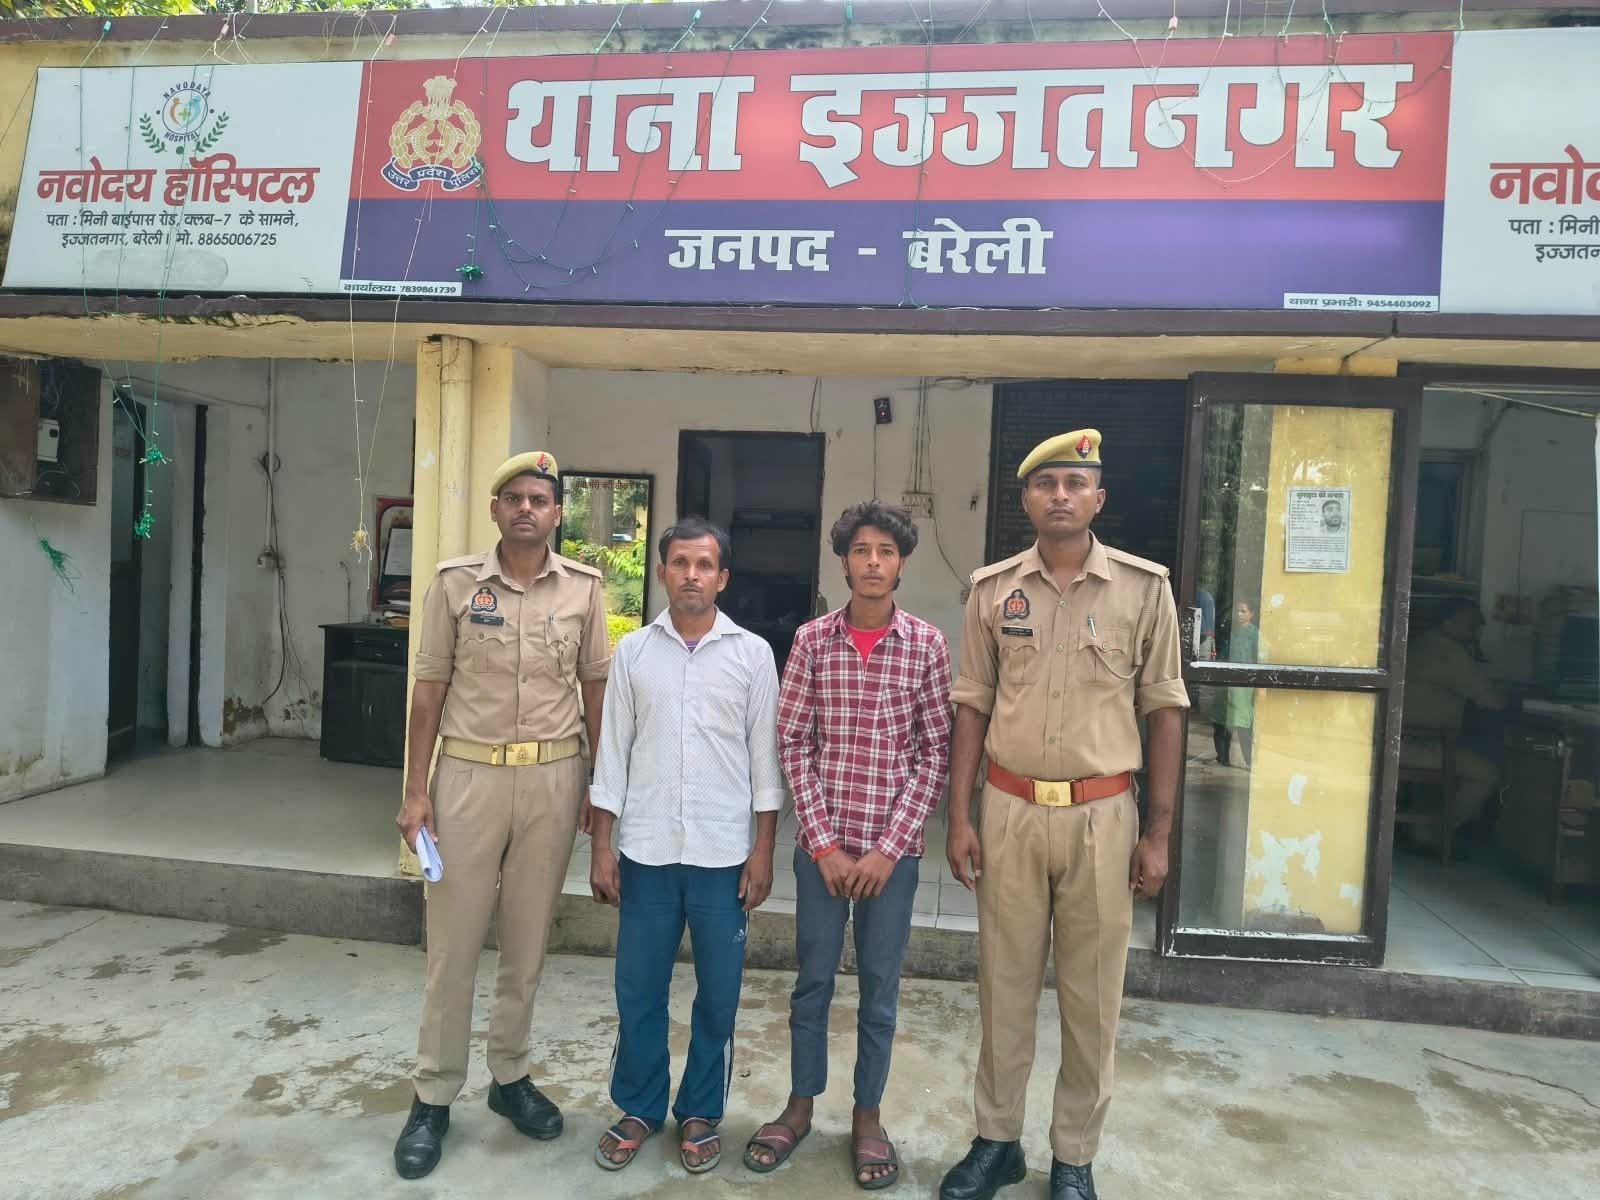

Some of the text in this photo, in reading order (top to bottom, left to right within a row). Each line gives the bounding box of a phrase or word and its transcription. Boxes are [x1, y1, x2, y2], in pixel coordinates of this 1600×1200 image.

[163, 81, 211, 99] NAVODAYA
[505, 63, 1414, 189] थाना इज्जतनगर
[164, 132, 200, 142] HOSPITAL
[36, 153, 321, 207] नवोदय हॉस्पिटल
[46, 214, 70, 226] पता
[80, 210, 109, 226] मिनी
[111, 210, 157, 229] बाईपास
[239, 210, 255, 226] के
[258, 210, 299, 227] सामने,
[1508, 219, 1542, 235] पता
[62, 233, 128, 248] इज्जतनगर,
[197, 233, 277, 245] 8865006725
[664, 229, 835, 272] जनपद
[902, 217, 1054, 274] बरेली
[400, 285, 457, 294] 7839861739
[1367, 299, 1432, 308] 9454403092
